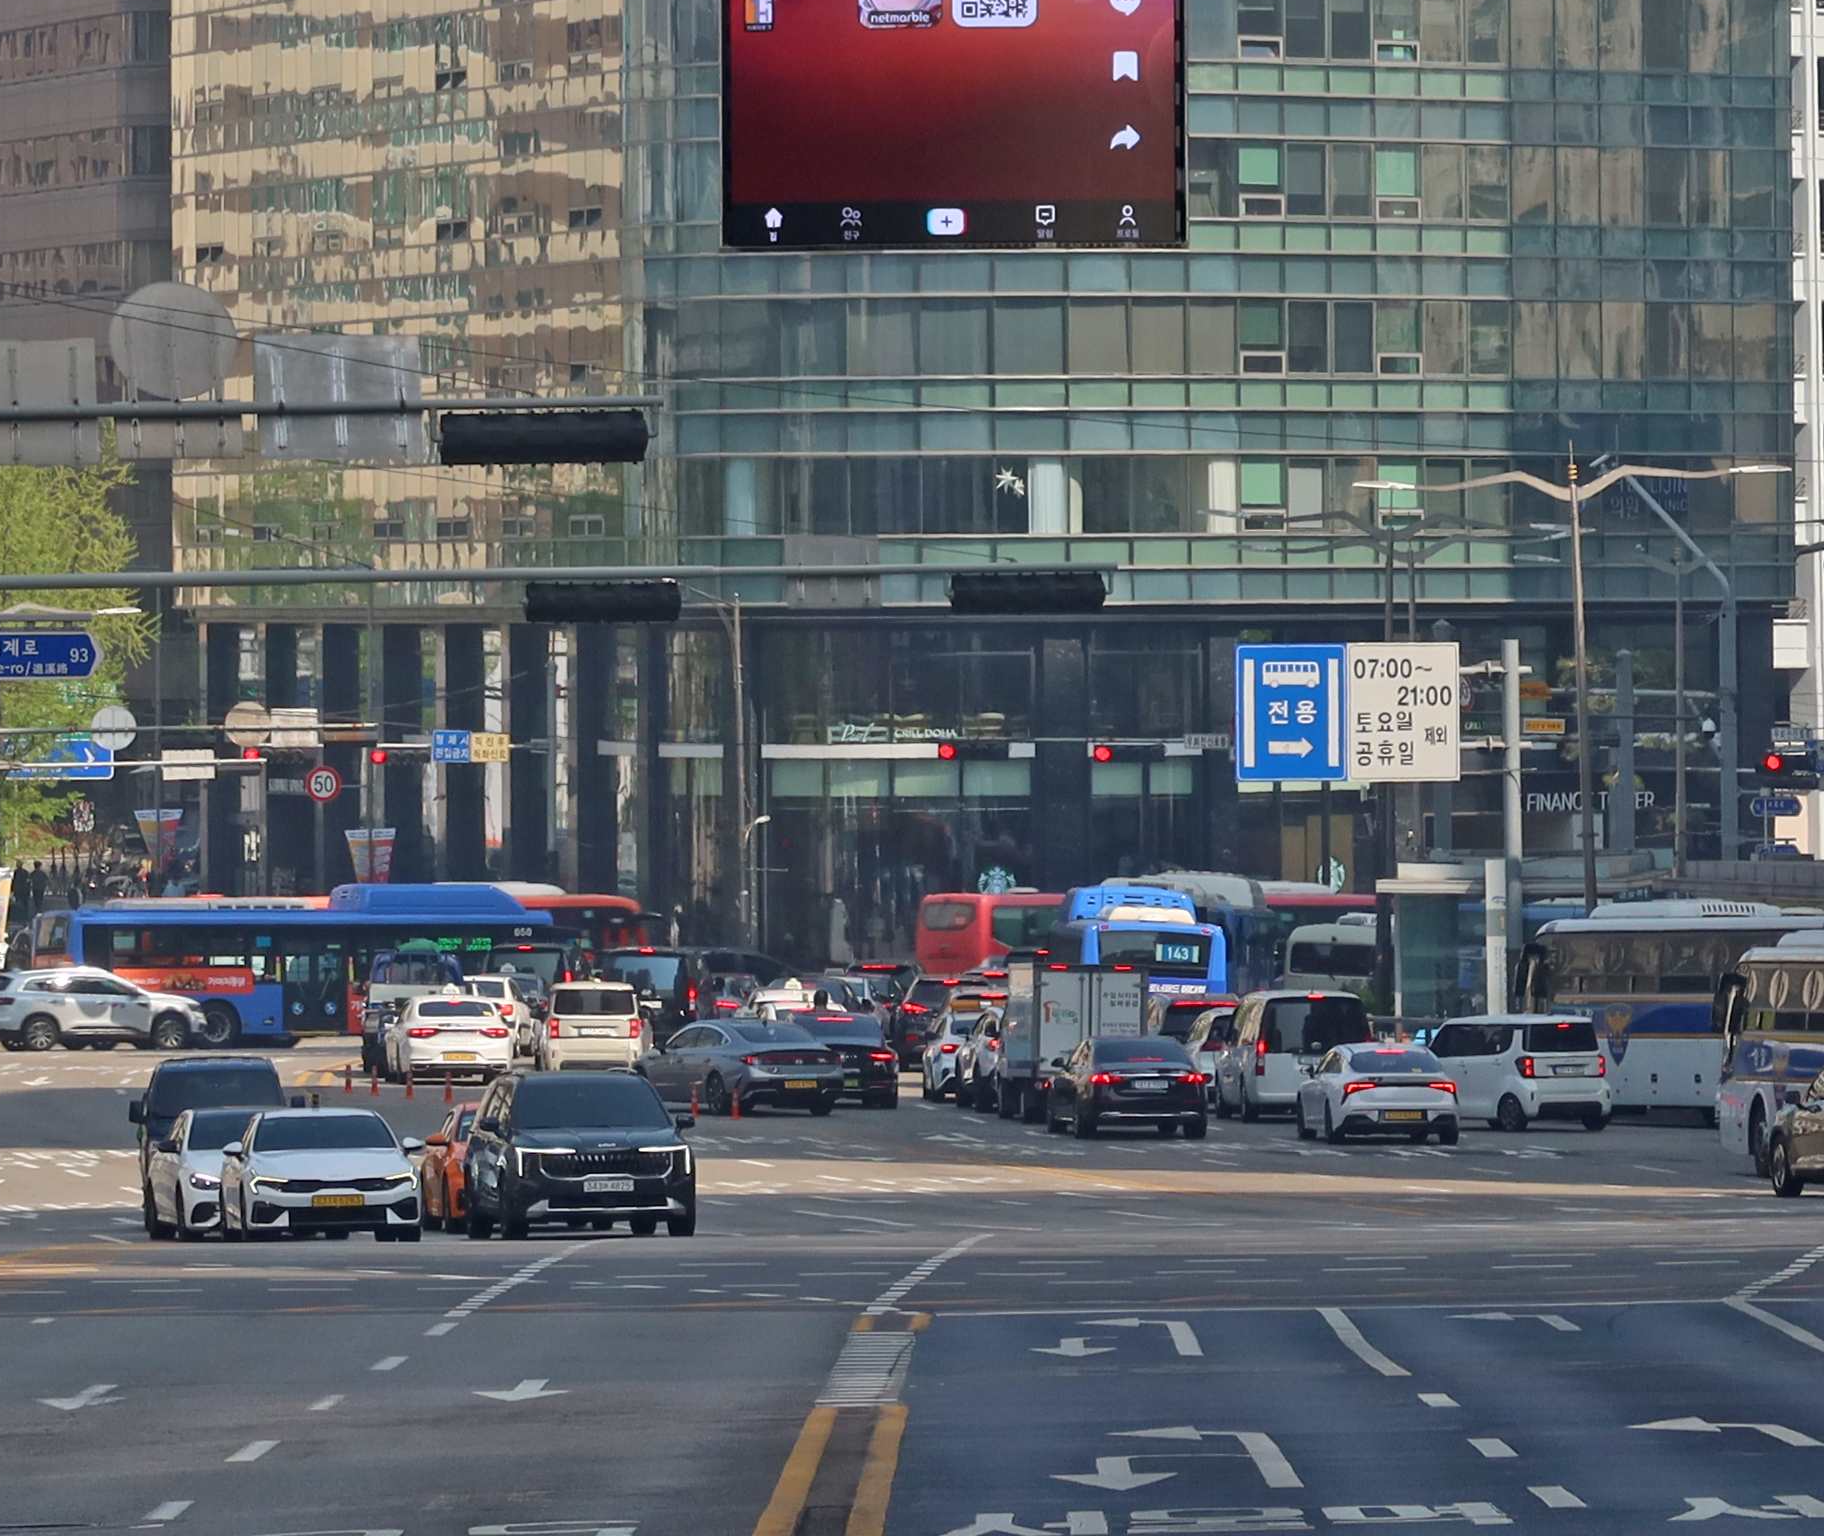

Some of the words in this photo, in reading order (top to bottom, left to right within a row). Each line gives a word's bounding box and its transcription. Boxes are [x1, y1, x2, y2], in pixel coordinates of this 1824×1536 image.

[870, 11, 931, 25] netmarble
[69, 648, 89, 663] 93
[1397, 685, 1453, 706] 21:00
[1267, 699, 1318, 725] 전용
[1355, 711, 1414, 734] 토요일
[1424, 725, 1448, 746] 제외
[1355, 740, 1415, 767] 공휴일
[313, 775, 335, 793] 50
[1166, 946, 1189, 961] 143
